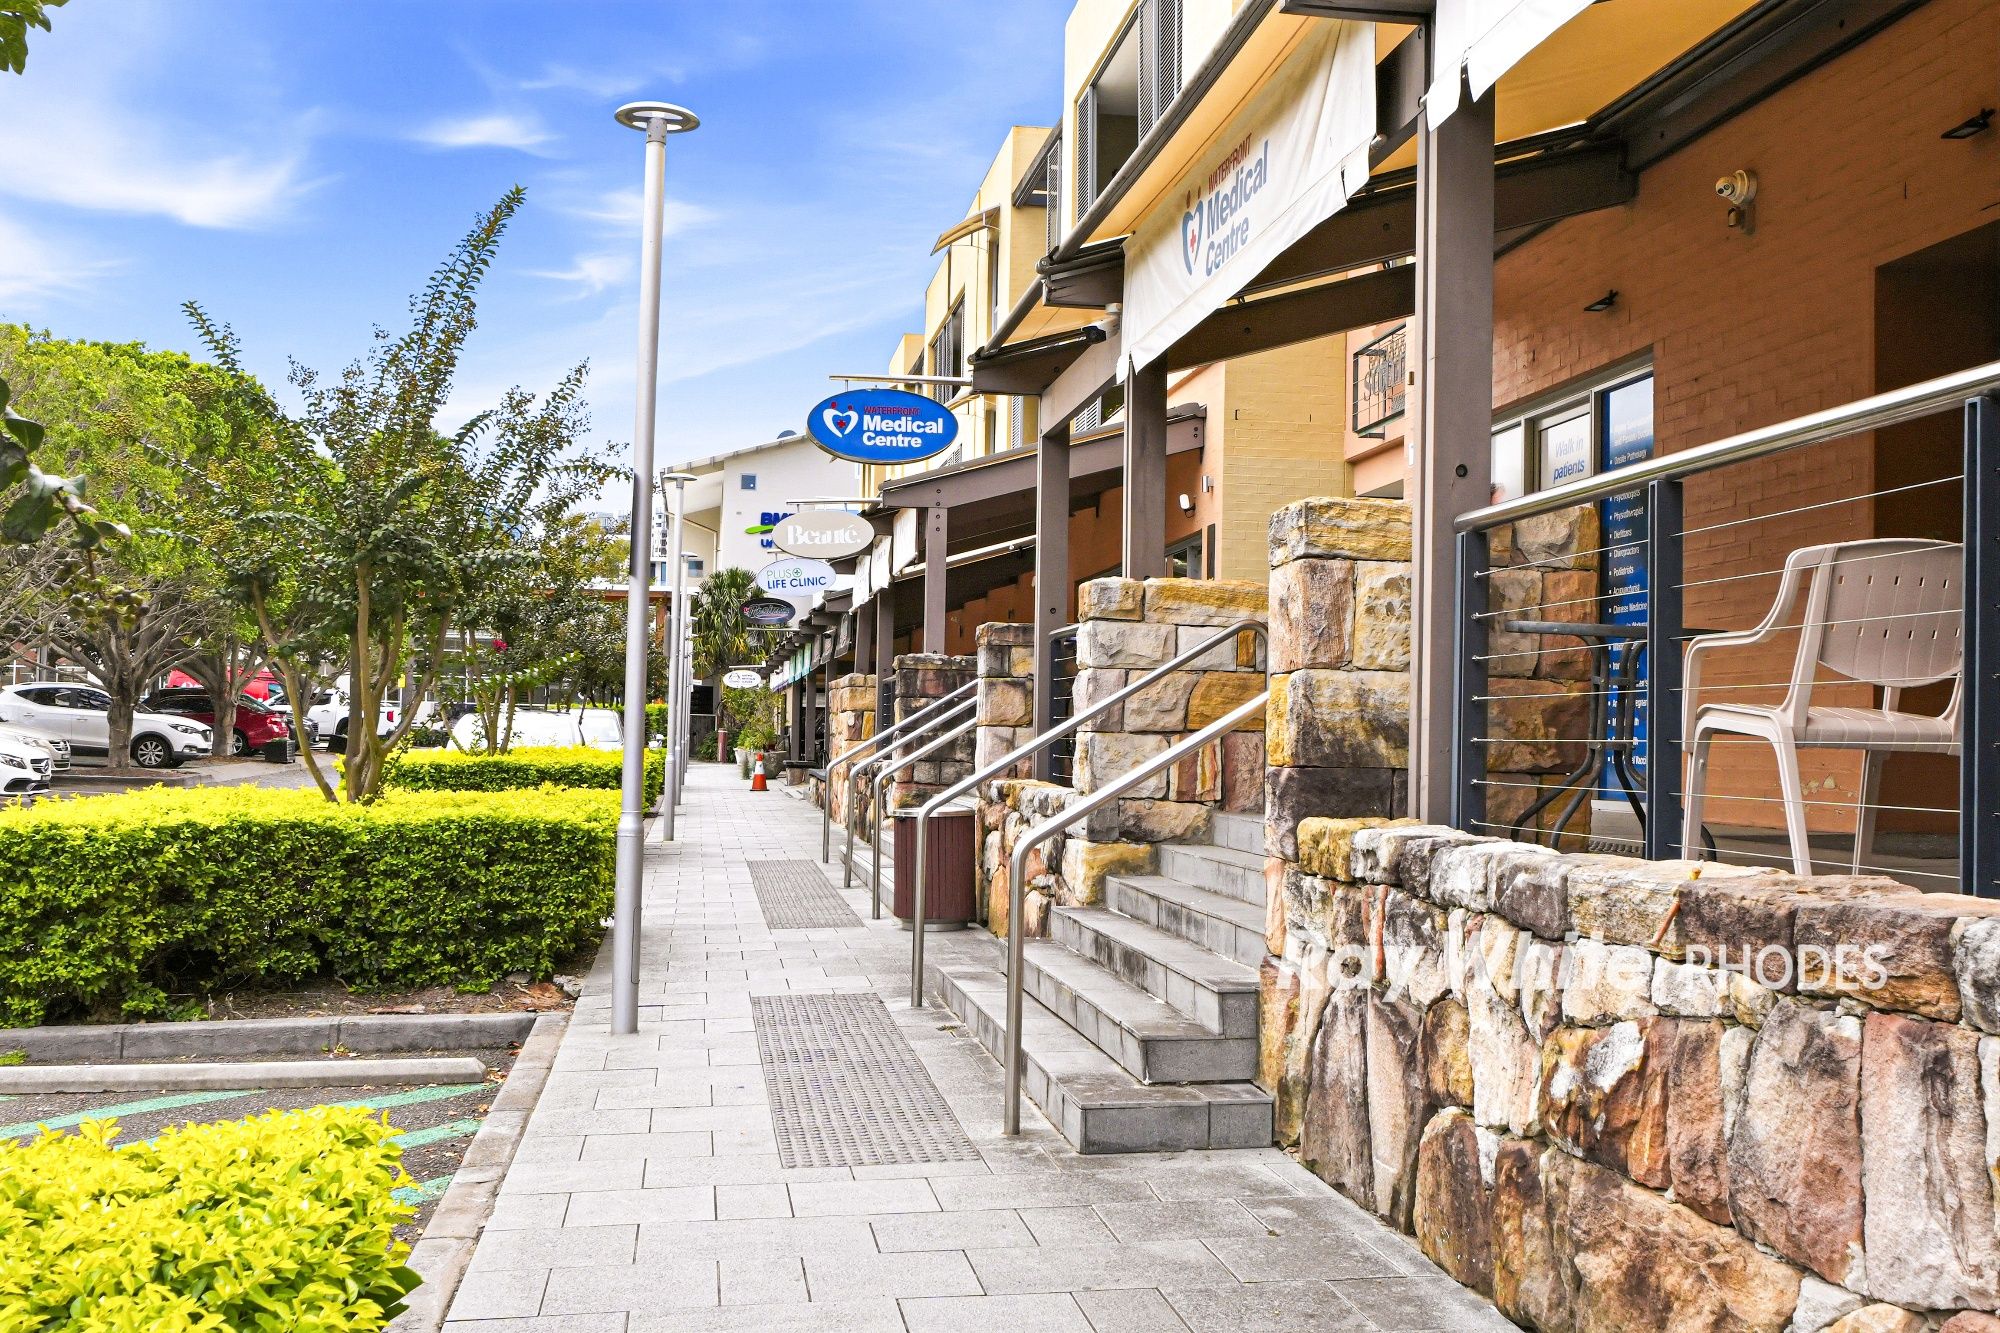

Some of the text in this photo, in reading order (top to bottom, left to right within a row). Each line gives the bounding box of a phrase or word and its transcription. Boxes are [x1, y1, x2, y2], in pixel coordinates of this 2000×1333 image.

[1209, 133, 1252, 194] WATERFRONT
[1207, 139, 1269, 239] Medical
[1206, 217, 1249, 276] Centre
[864, 406, 920, 415] WATERFRONT
[863, 415, 943, 434] Medical
[862, 431, 922, 448] Centre
[1555, 437, 1584, 457] Walk in
[1553, 459, 1585, 484] patients
[767, 568, 792, 579] PLUS
[768, 576, 827, 589] LIFE CLINIC
